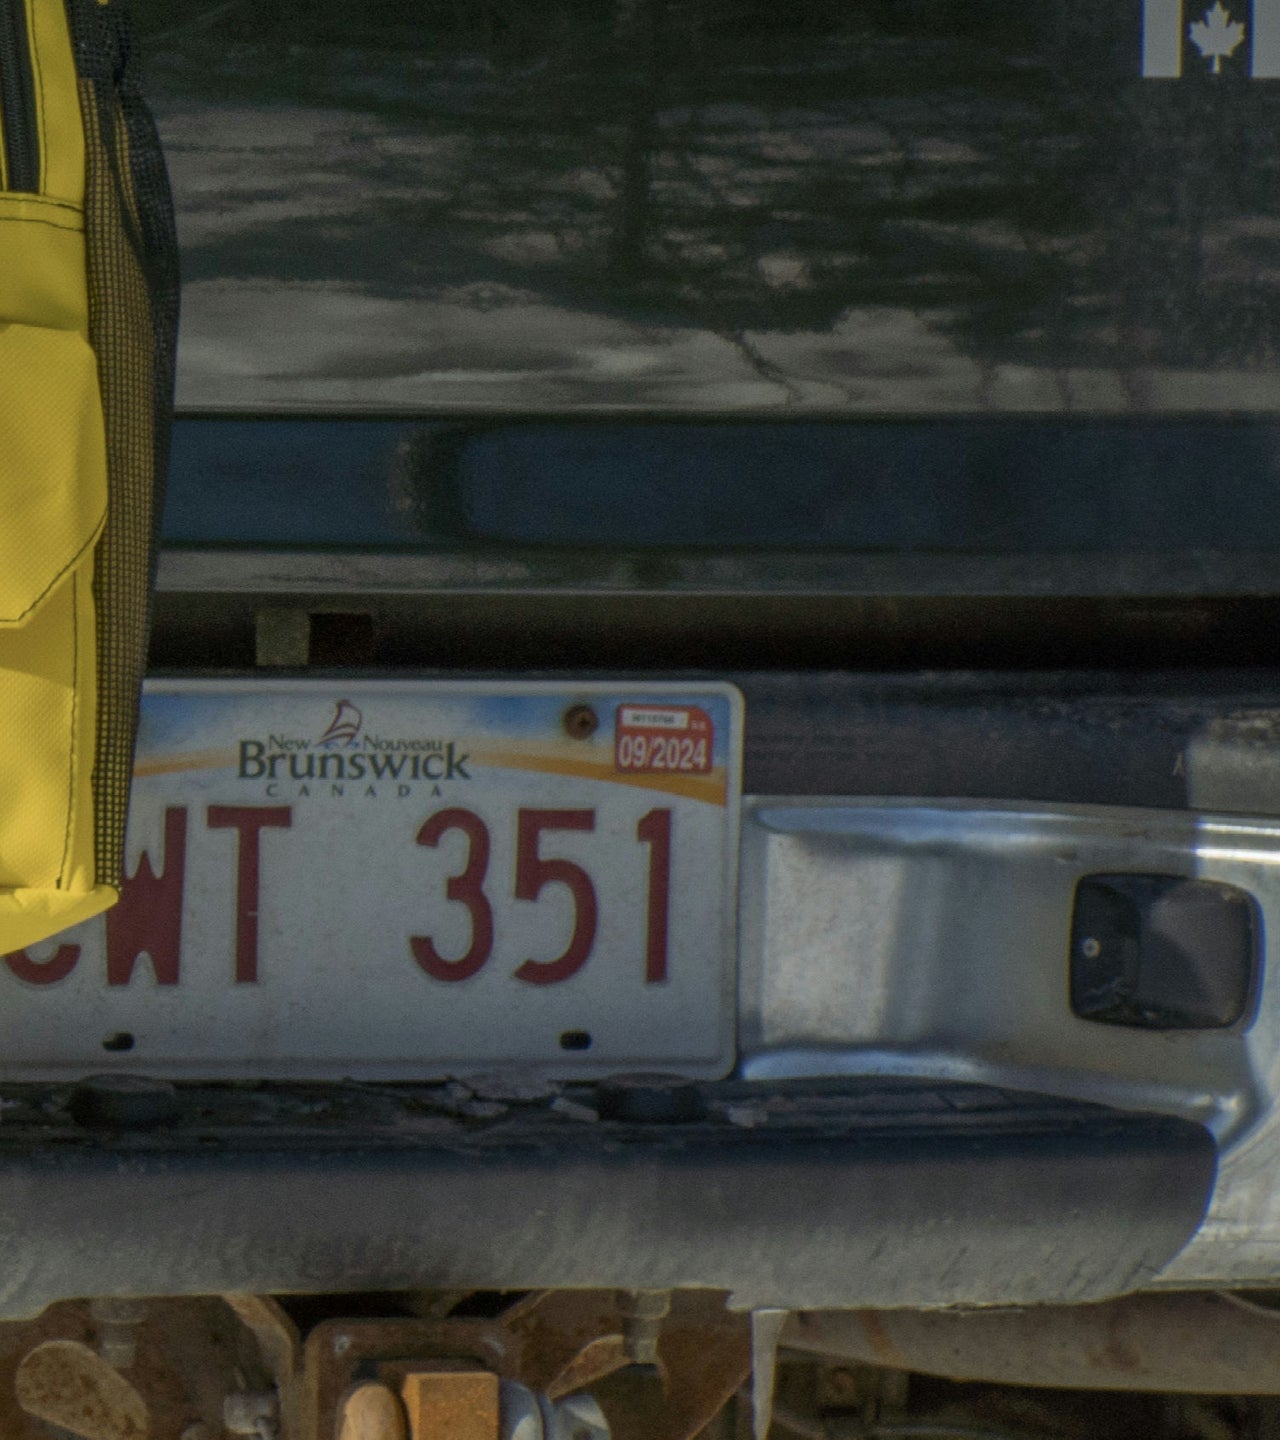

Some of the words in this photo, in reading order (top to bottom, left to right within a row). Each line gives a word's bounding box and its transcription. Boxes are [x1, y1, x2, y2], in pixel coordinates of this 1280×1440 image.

[238, 740, 471, 780] Brunswick
[268, 734, 311, 751] New
[362, 735, 444, 752] Nouveau
[619, 735, 707, 770] 09/2024
[266, 784, 443, 798] CANADA
[3, 806, 293, 986] WT
[408, 808, 672, 985] 351
